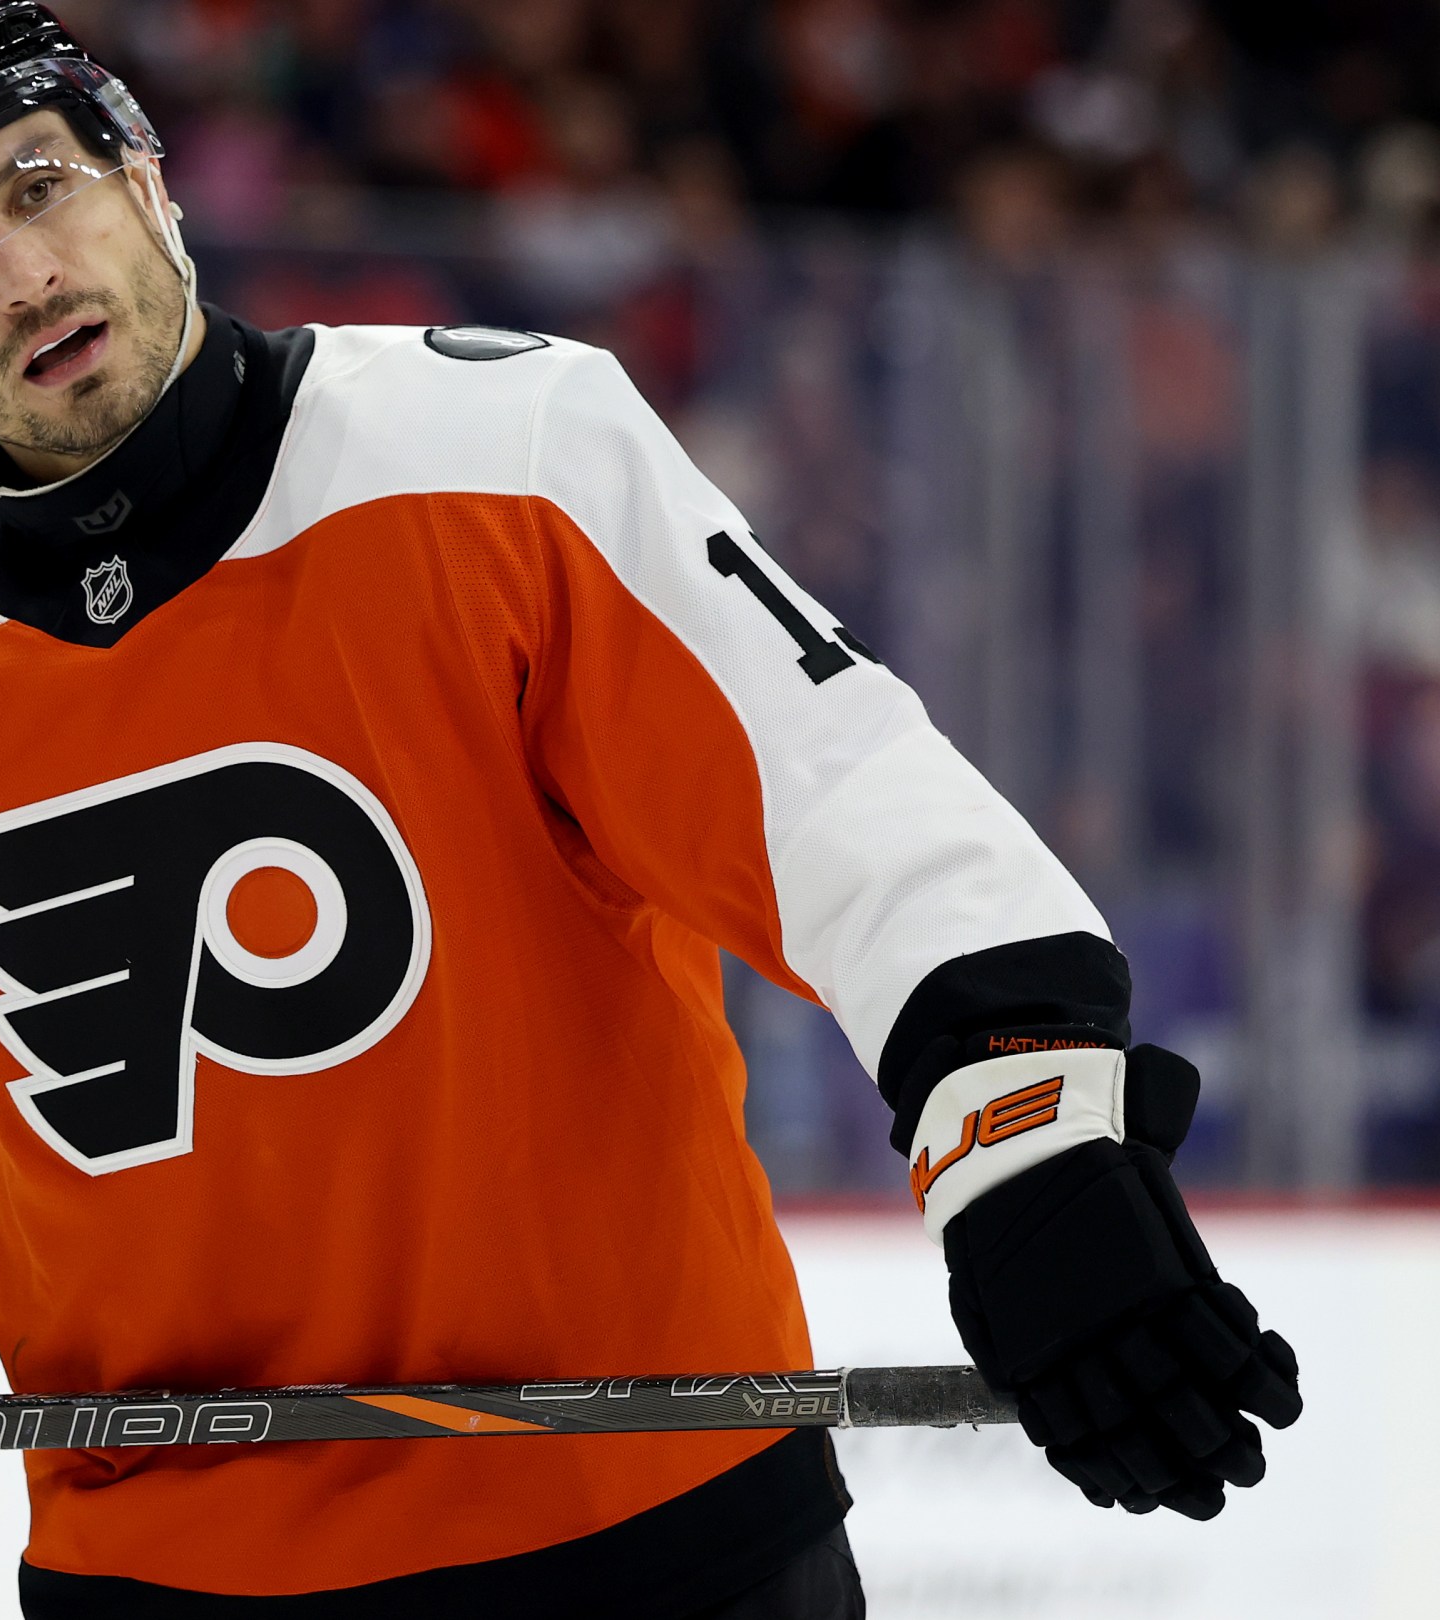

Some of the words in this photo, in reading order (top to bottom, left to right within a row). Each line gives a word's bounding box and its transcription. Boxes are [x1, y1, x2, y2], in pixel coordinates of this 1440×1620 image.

[97, 574, 121, 615] NHL
[706, 530, 886, 686] 1
[910, 1075, 1065, 1216] UE
